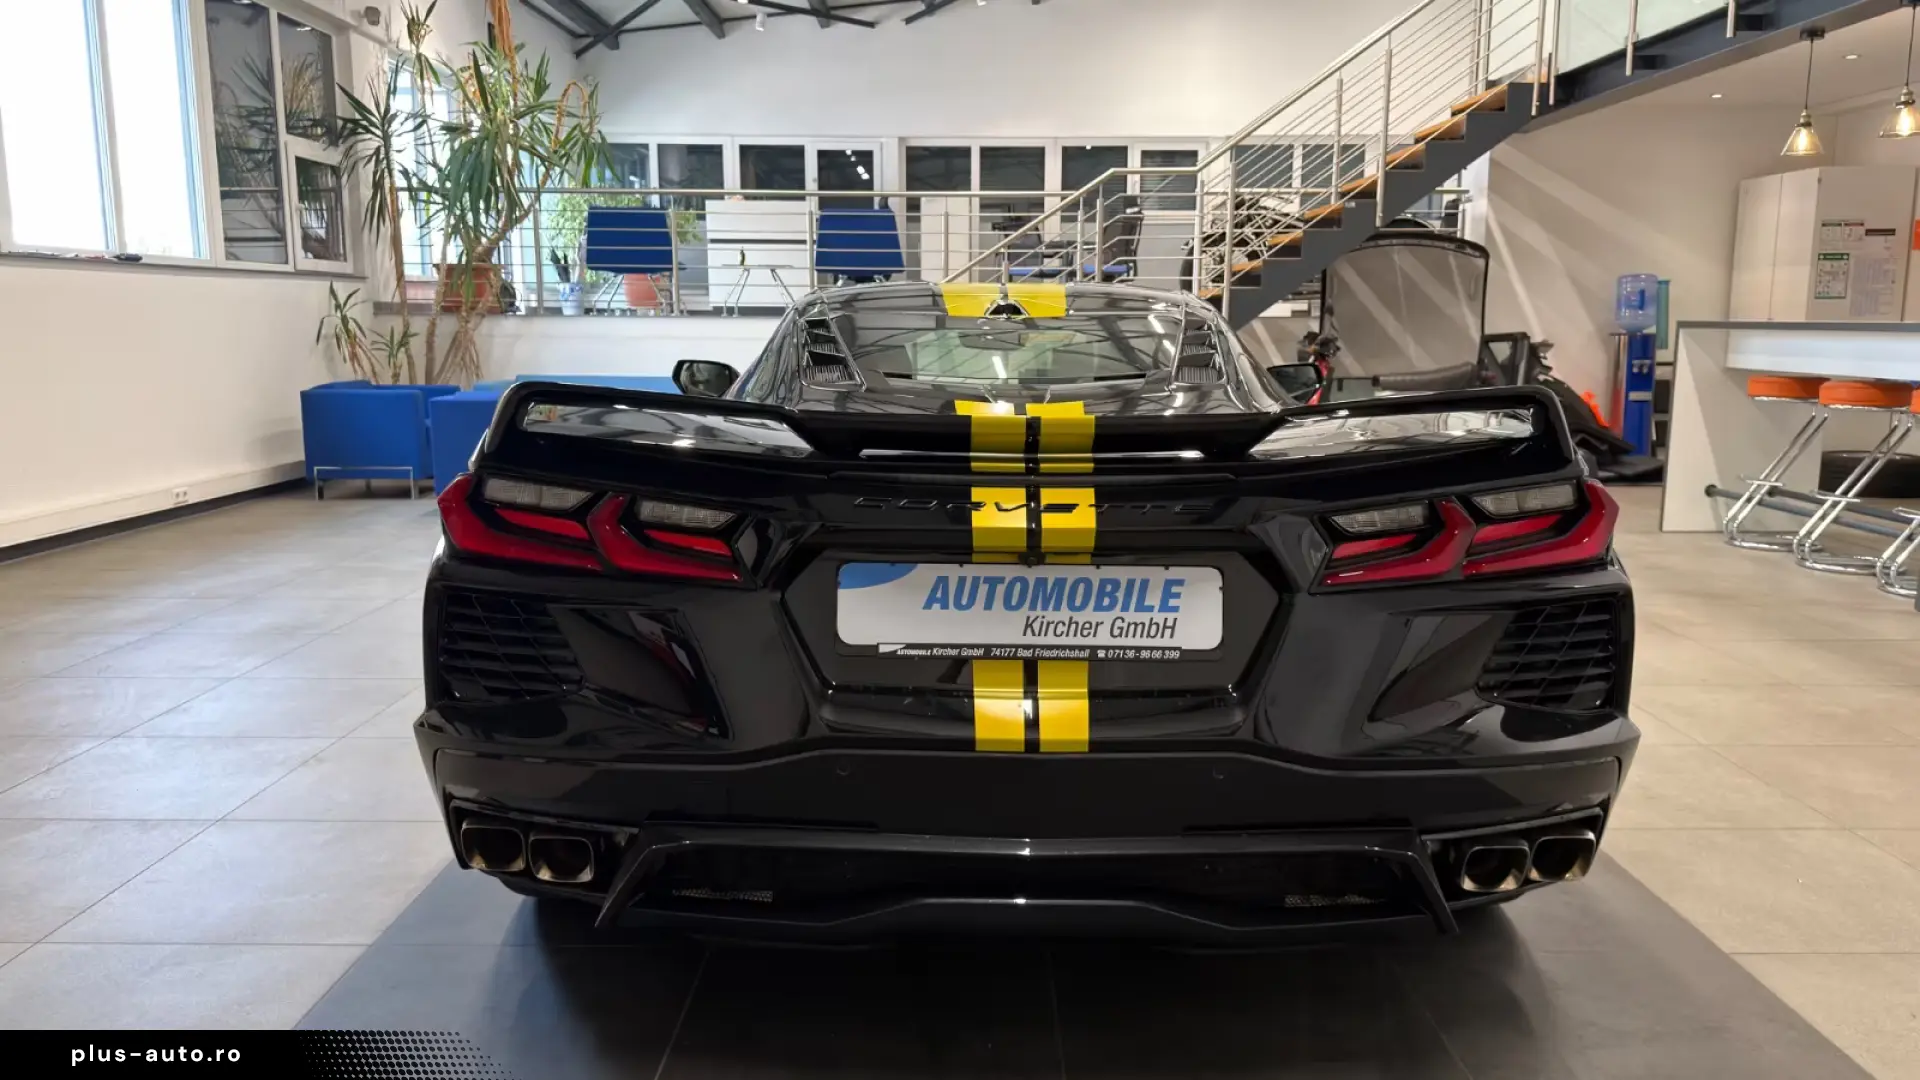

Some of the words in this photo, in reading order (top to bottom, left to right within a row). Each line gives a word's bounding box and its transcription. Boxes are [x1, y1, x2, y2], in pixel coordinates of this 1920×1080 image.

[922, 575, 1186, 613] AUTOMOBILE
[1022, 615, 1104, 638] Kircher
[1109, 616, 1178, 639] GmbH
[932, 647, 960, 656] Kircher
[960, 647, 984, 656] GmbH
[990, 648, 1015, 657] 74177
[1017, 648, 1033, 657] Bad
[1034, 648, 1090, 658] Friedrichshall
